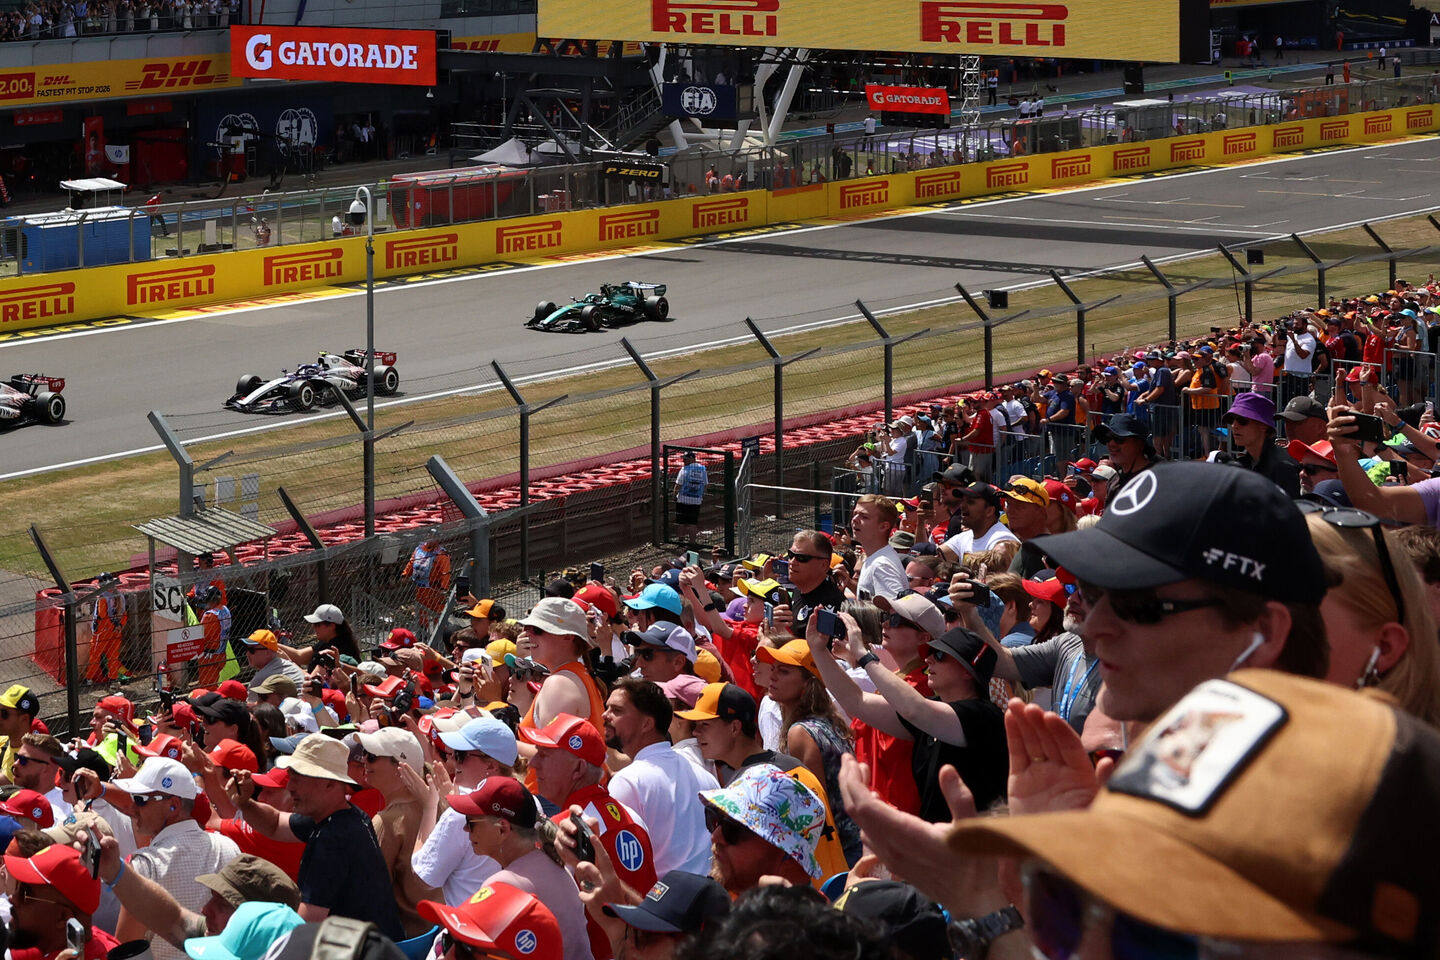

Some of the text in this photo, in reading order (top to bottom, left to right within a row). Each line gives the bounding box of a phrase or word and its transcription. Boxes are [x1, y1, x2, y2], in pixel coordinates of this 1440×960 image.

[278, 41, 418, 70] GATORADE
[44, 75, 71, 86] DHL
[139, 60, 215, 89] DHL
[37, 89, 64, 97] FASTEST
[66, 87, 76, 95] PIT
[78, 86, 93, 95] STOP
[886, 94, 942, 105] GATORADE
[1224, 133, 1256, 154] PIRELLI
[1274, 127, 1303, 147] PIRELLI
[1114, 147, 1150, 170] PIRELLI
[1171, 140, 1205, 162] PIRELLI
[619, 168, 659, 178] ZERO
[987, 163, 1028, 187] PIRELLI
[1052, 155, 1090, 179] PIRELLI
[840, 181, 888, 208] PIRELLI
[916, 172, 960, 197] PIRELLI
[600, 210, 659, 241] PIRELLI
[693, 198, 748, 228] PIRELLI
[496, 220, 562, 254] PIRELLI
[386, 234, 458, 268] PIRELLI
[264, 248, 343, 285] PIRELLI
[127, 264, 215, 305] PIRELLI
[1223, 552, 1266, 580] FTX
[155, 582, 180, 614] SC
[620, 834, 640, 870] hp
[518, 931, 535, 952] hp
